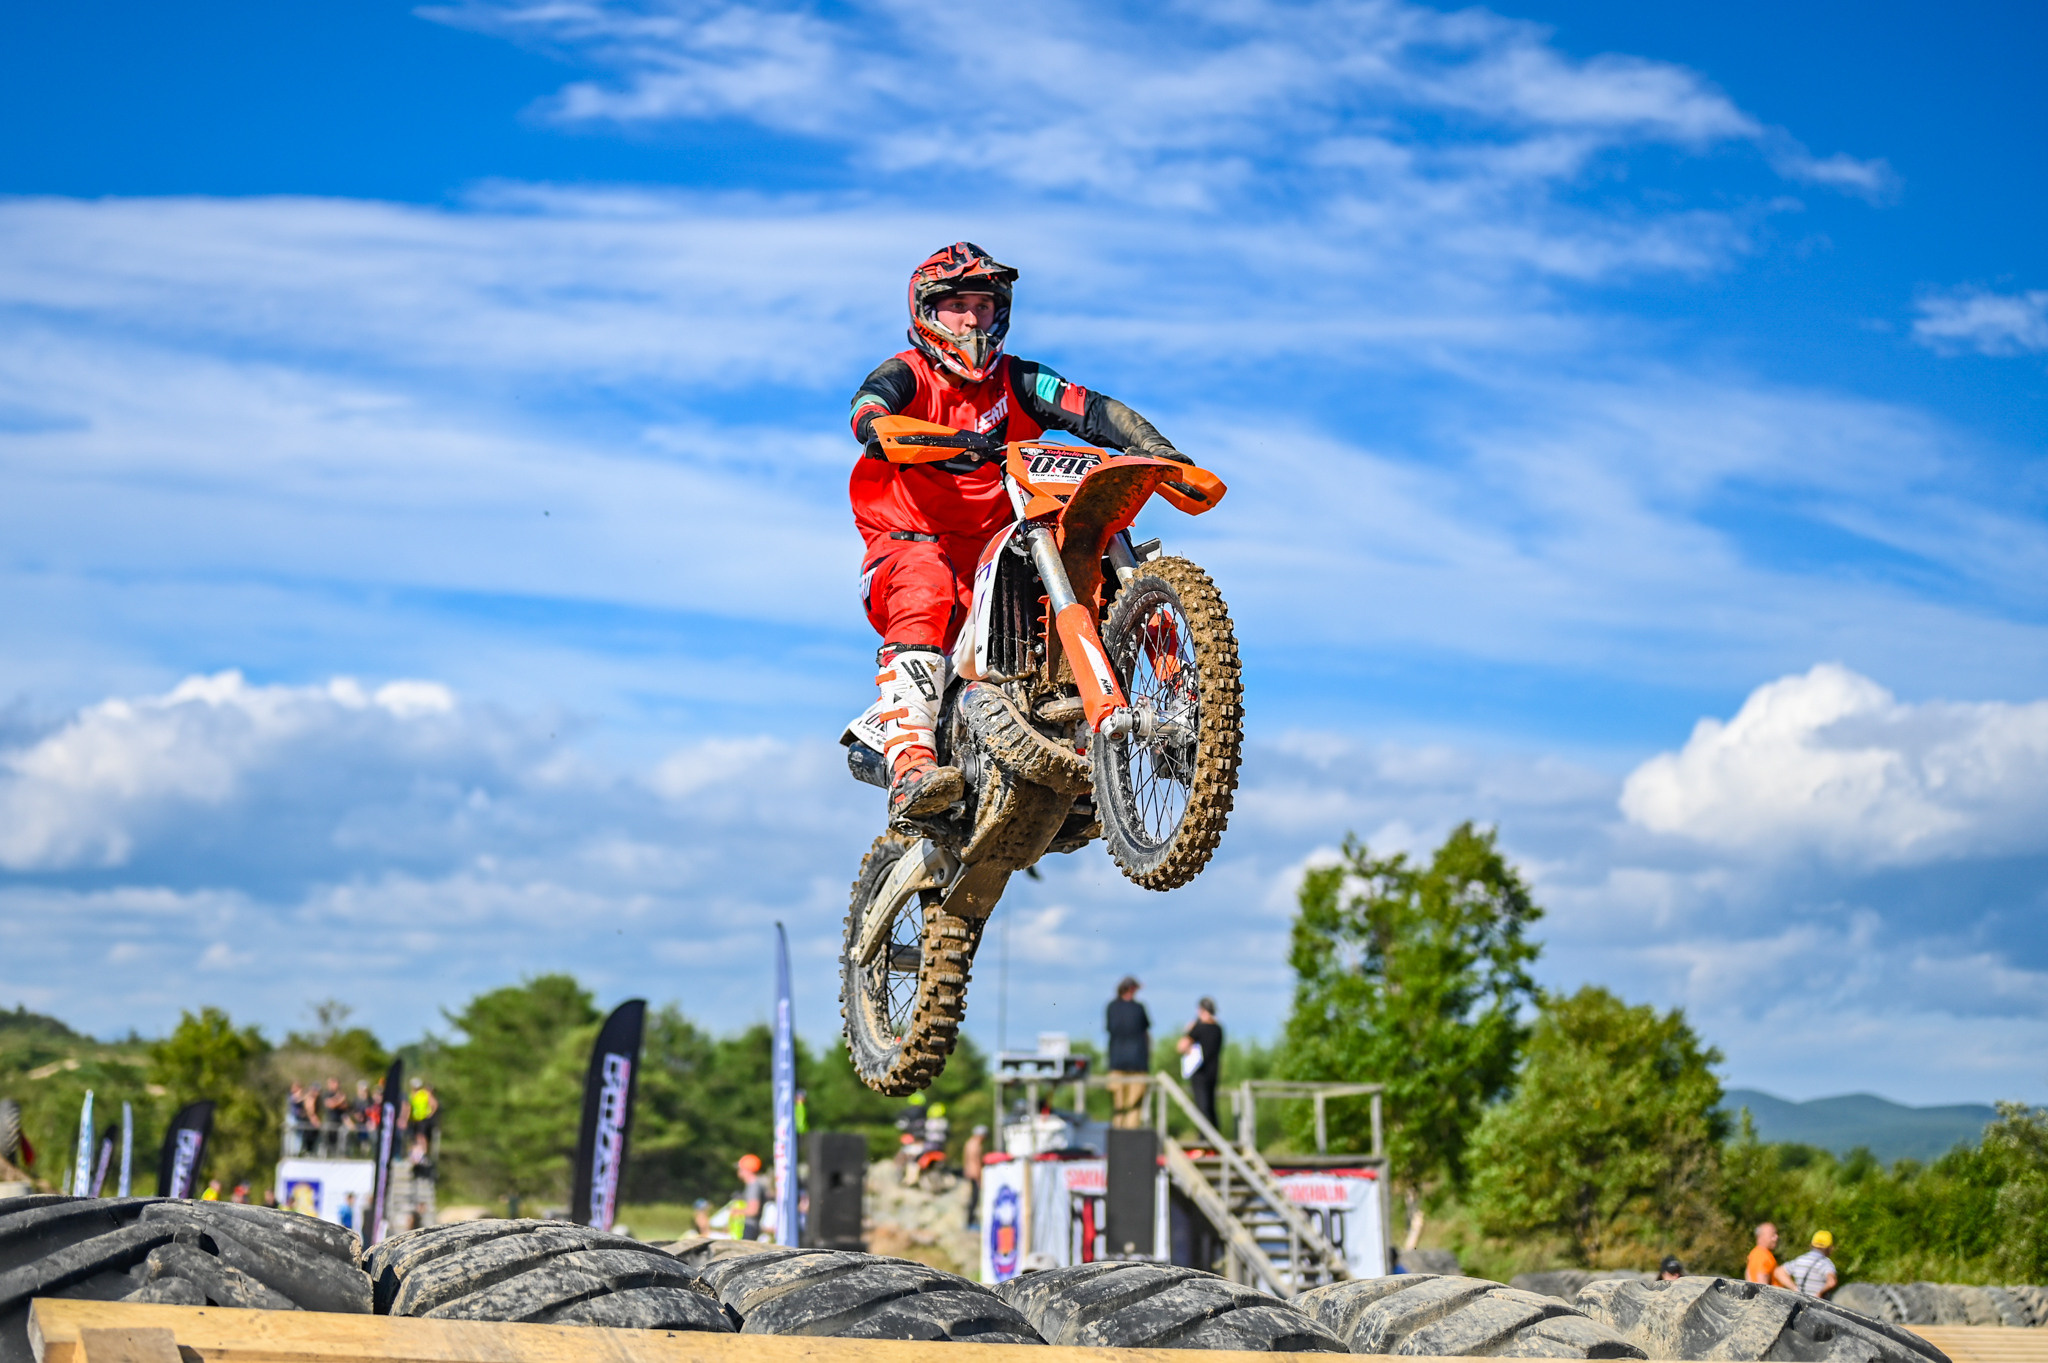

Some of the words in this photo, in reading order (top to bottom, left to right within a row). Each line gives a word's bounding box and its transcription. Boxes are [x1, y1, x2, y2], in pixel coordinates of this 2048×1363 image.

[1029, 456, 1102, 476] 046
[900, 658, 939, 702] SIDI
[1100, 678, 1114, 695] KTM
